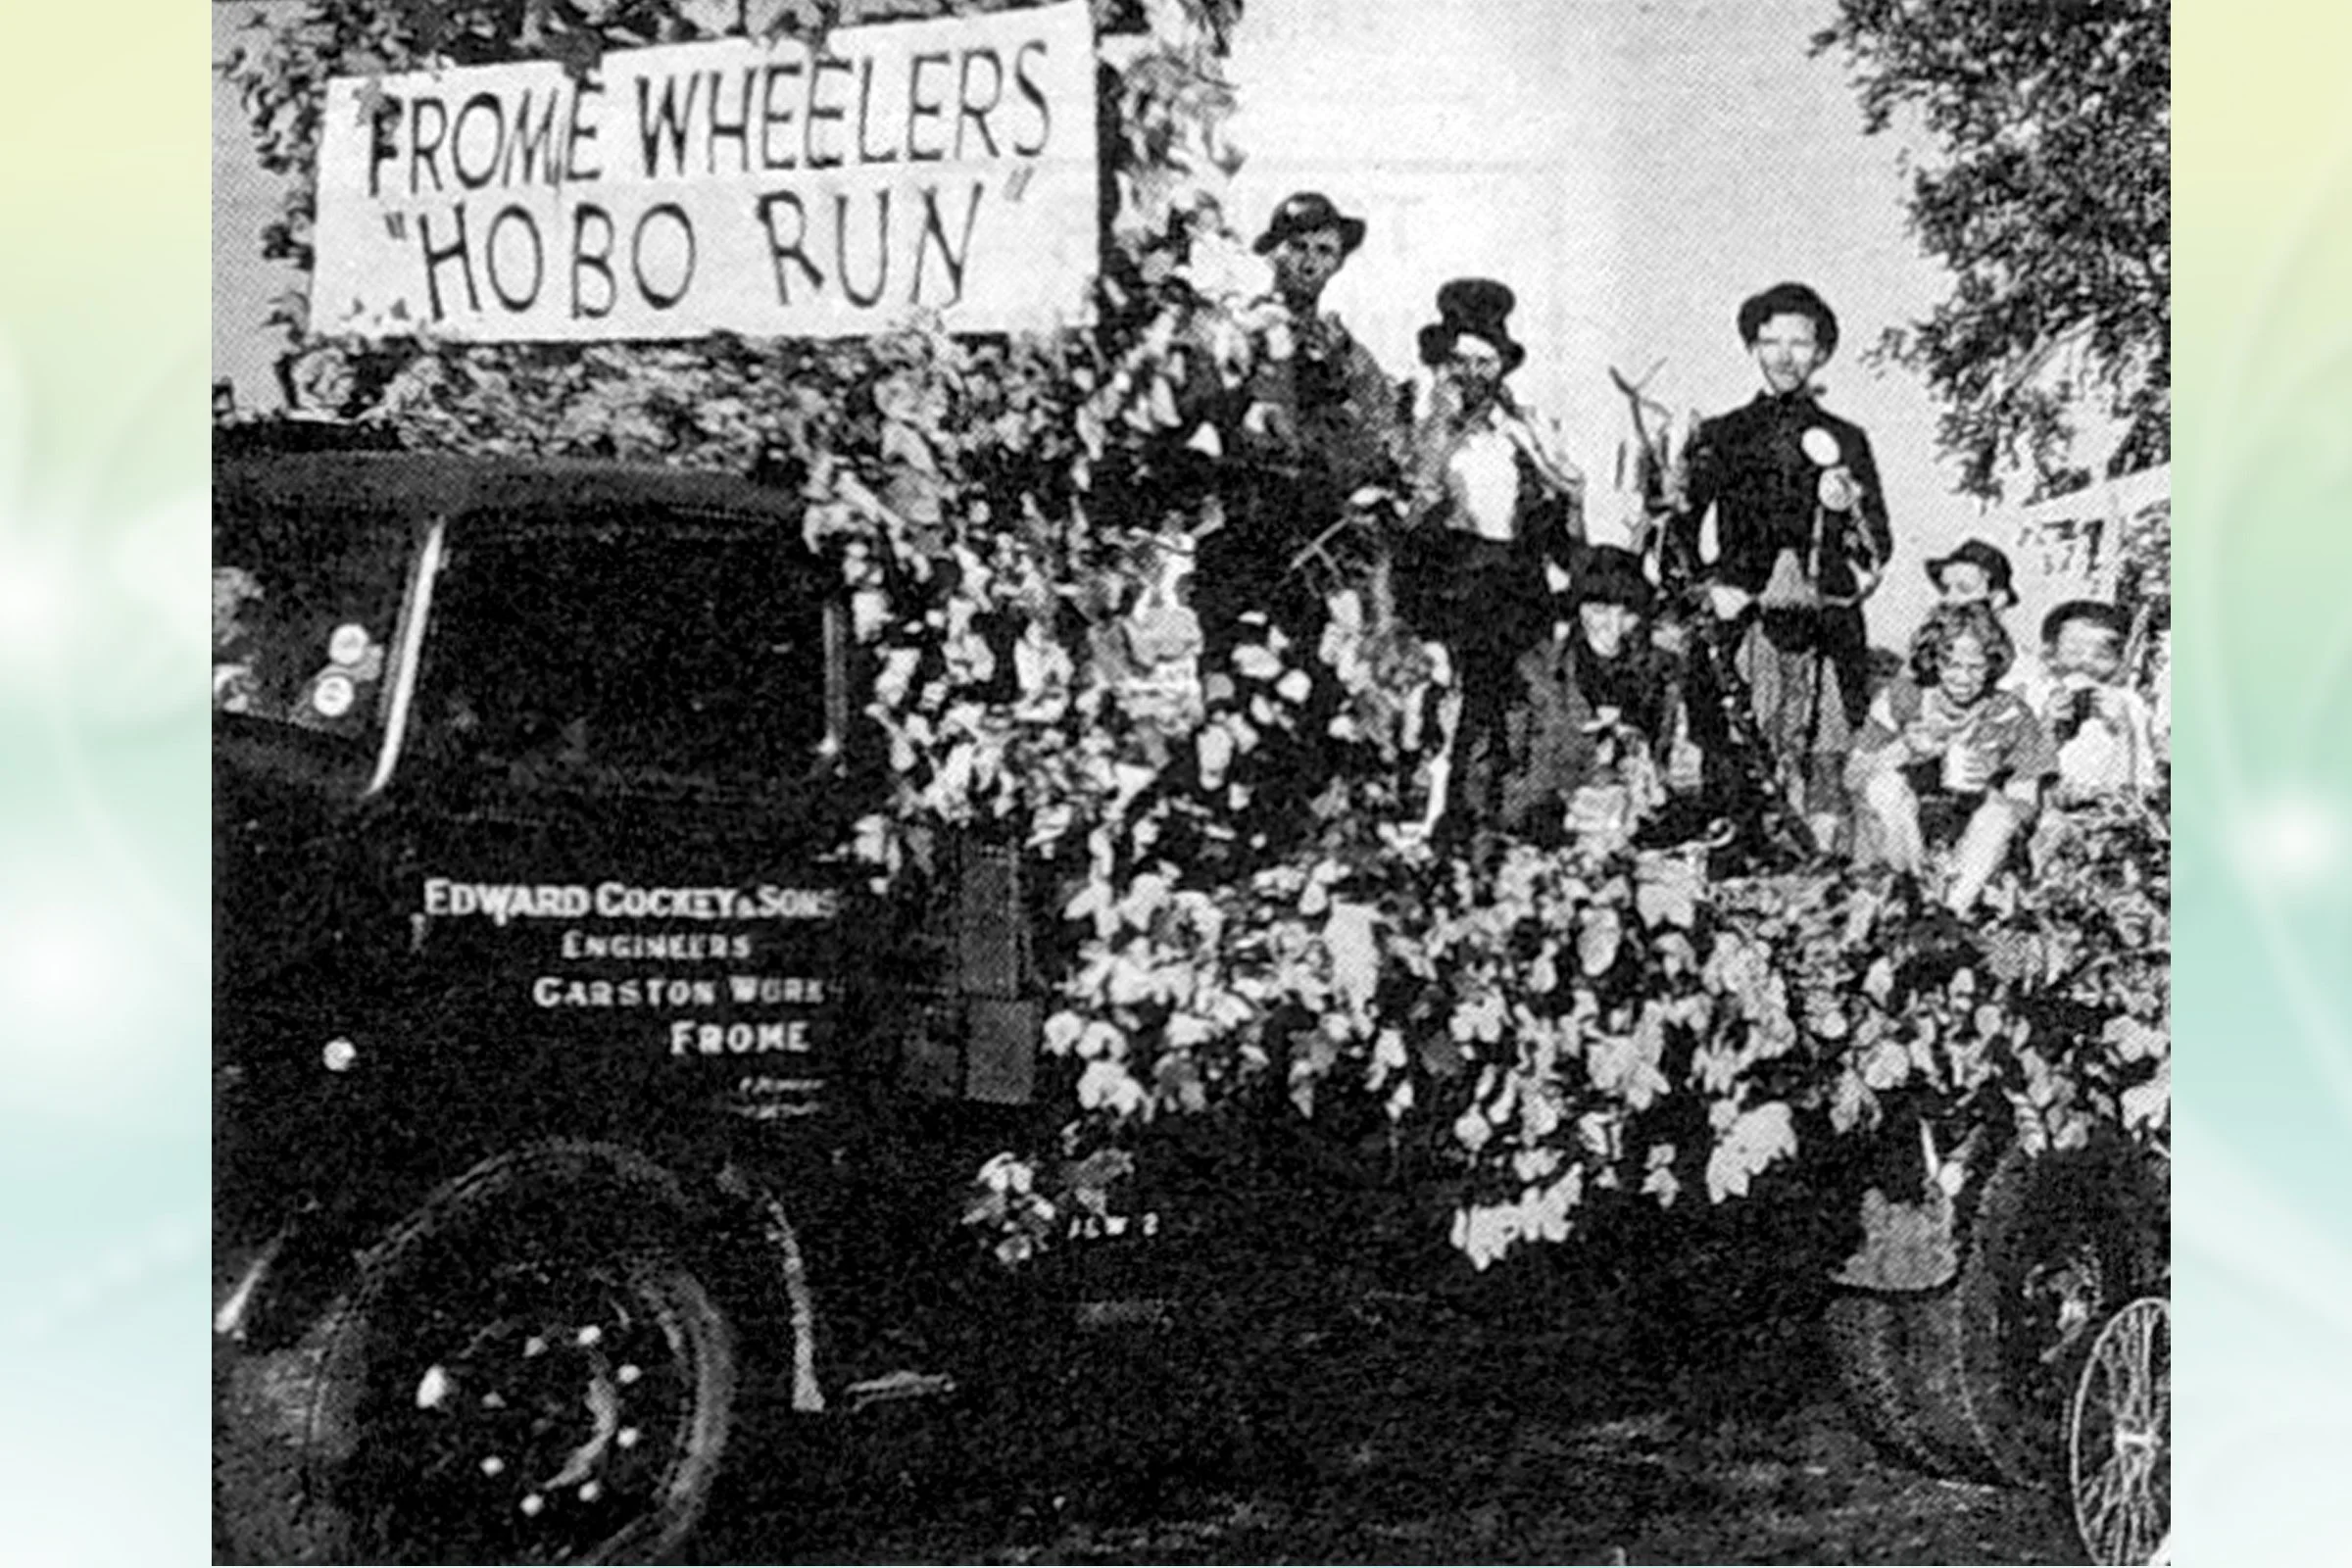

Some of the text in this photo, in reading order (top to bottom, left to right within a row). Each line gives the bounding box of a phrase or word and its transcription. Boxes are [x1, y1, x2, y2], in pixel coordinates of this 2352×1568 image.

[368, 39, 1053, 197] FROME WHEELERS
[383, 200, 697, 322] "HOBO
[423, 878, 590, 923] EDWARD
[561, 928, 752, 959] ENGINEERS
[670, 1020, 810, 1054] FROME
